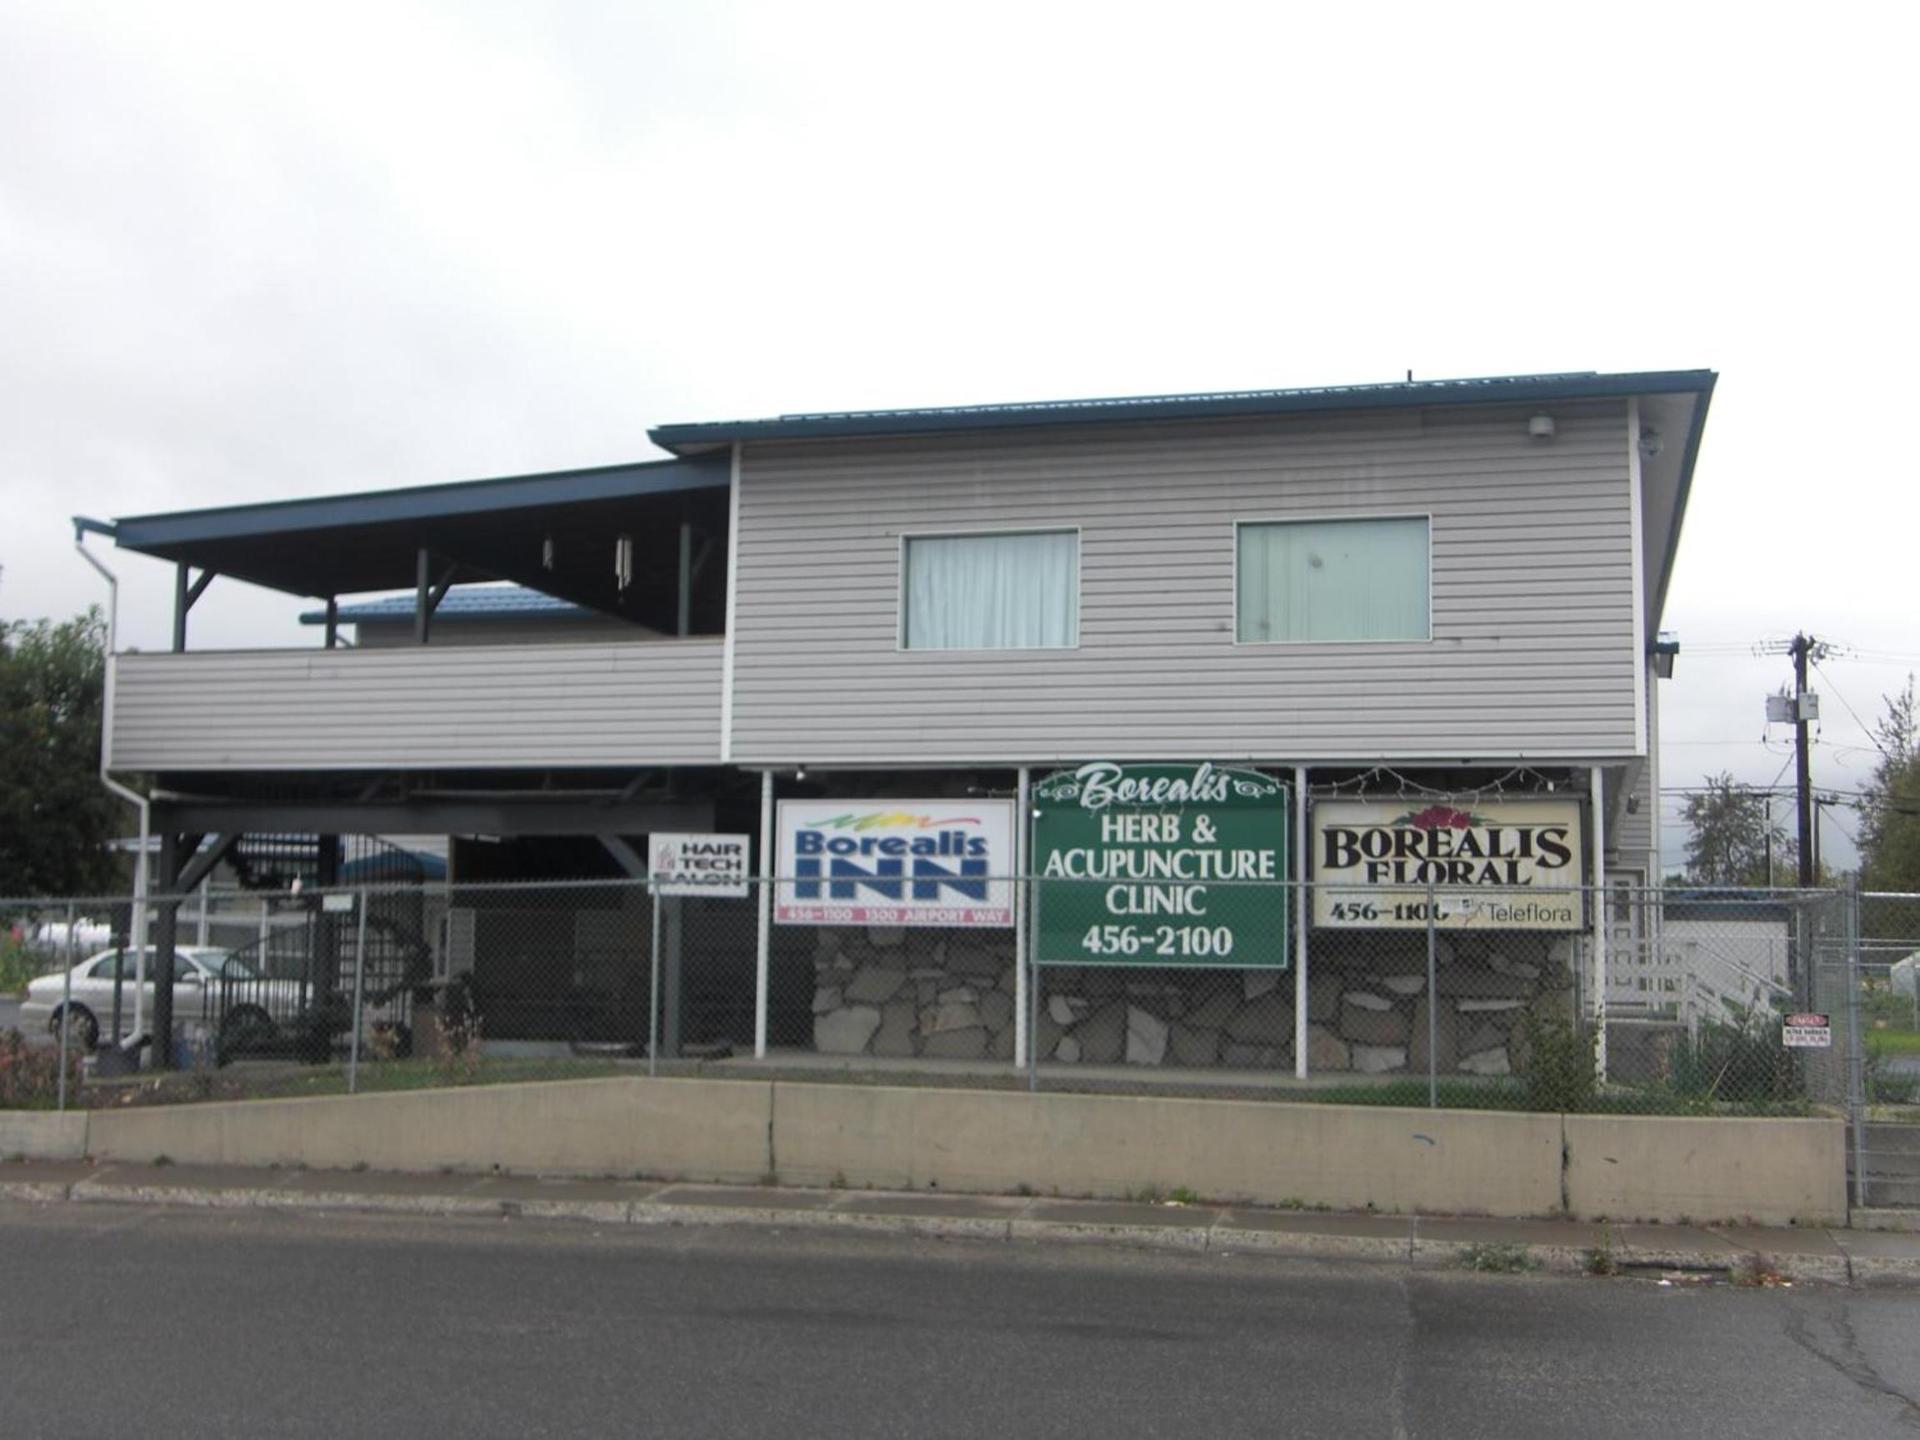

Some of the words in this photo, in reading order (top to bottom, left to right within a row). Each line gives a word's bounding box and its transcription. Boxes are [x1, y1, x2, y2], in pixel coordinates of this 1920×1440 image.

[1075, 762, 1231, 809] Borealis
[795, 830, 987, 856] Borealis
[1101, 813, 1180, 843] HERB
[1191, 814, 1217, 843] &
[682, 843, 742, 856] HAIR
[1322, 827, 1573, 869] BOREALIS
[680, 858, 742, 870] TECH
[795, 858, 988, 900] INN
[1043, 848, 1276, 880] ACUPUNCTURE
[1365, 860, 1532, 885] FLORAL
[1105, 884, 1207, 915] CLINIC
[1487, 902, 1573, 922] Teleflora
[904, 907, 965, 922] AIRPORT
[972, 908, 1005, 923] WAY
[1082, 925, 1233, 956] 456-2100
